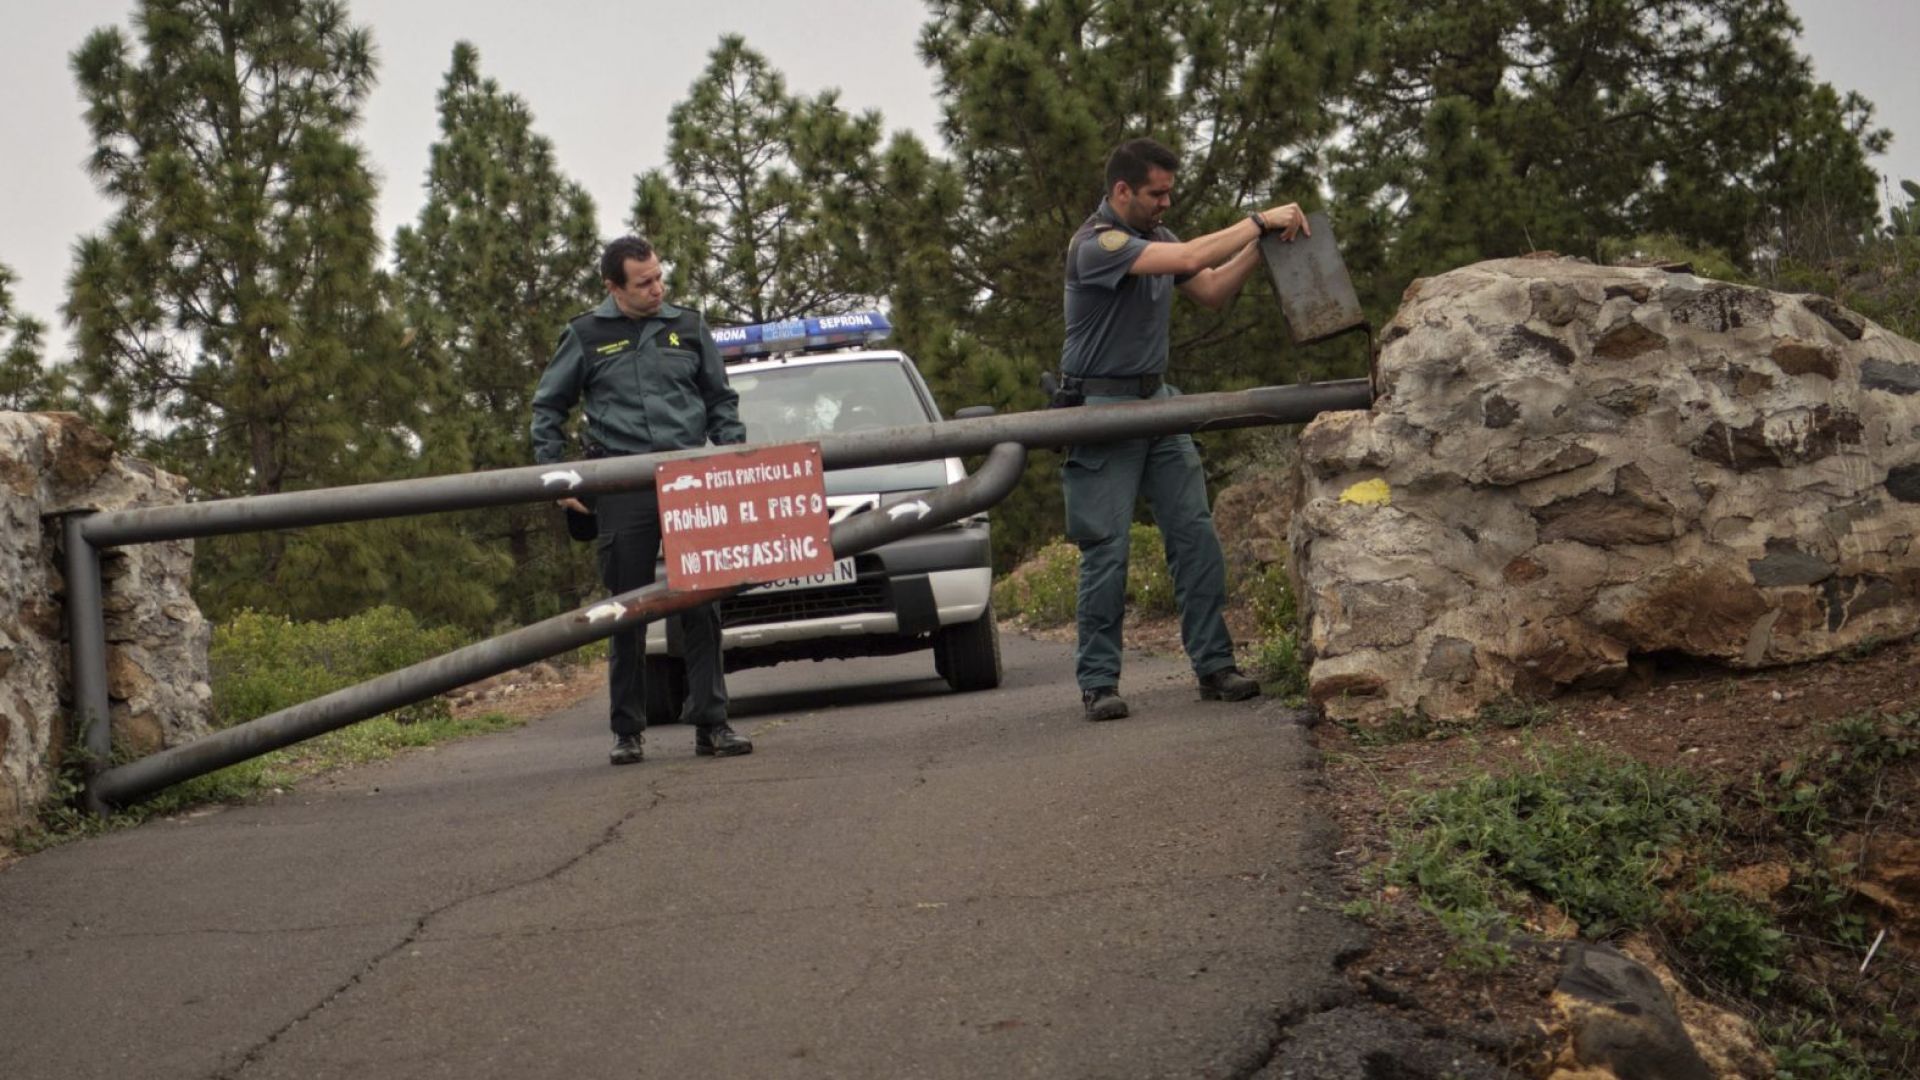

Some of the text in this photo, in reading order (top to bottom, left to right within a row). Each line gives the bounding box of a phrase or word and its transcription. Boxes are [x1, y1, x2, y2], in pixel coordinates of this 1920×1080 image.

[819, 315, 872, 330] SEPRONA
[711, 328, 747, 343] PRONA
[740, 501, 758, 524] EL
[768, 493, 823, 520] PASO
[680, 552, 701, 576] NO
